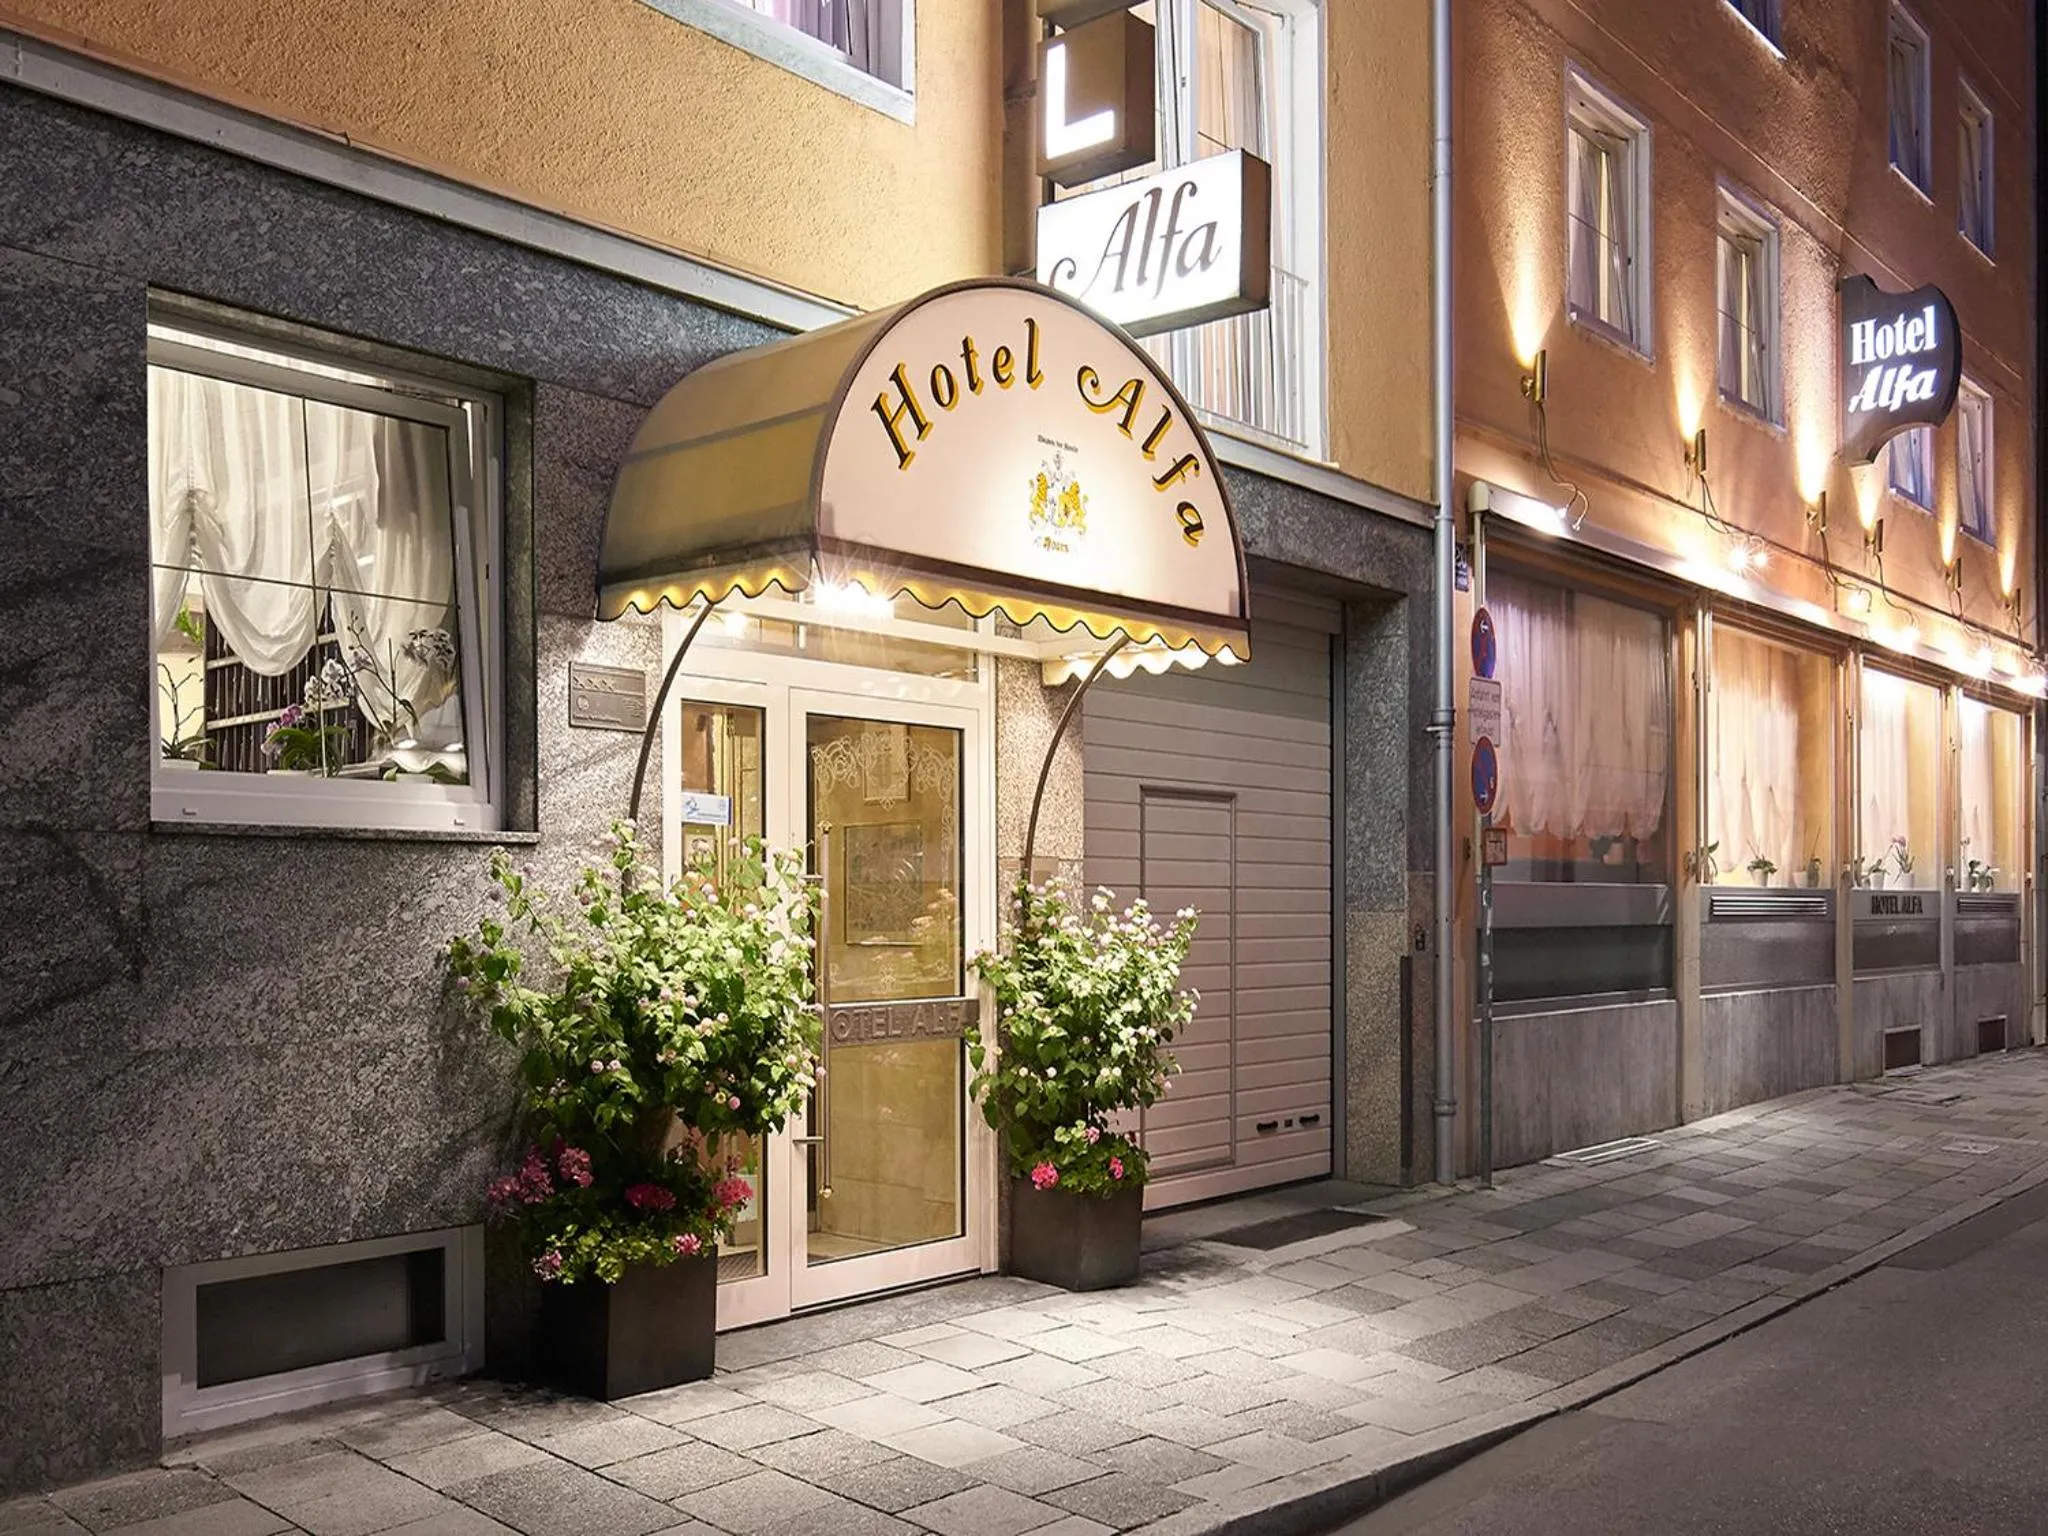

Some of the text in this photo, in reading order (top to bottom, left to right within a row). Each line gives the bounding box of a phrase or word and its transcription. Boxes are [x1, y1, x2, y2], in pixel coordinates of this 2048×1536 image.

[1049, 181, 1223, 300] Alfa
[1850, 305, 1939, 365] Hotel
[1848, 363, 1938, 413] Alfa
[870, 318, 1206, 547] Hotel Alfa
[1901, 895, 1923, 915] ALFA
[831, 1002, 964, 1040] OTEL ALF
